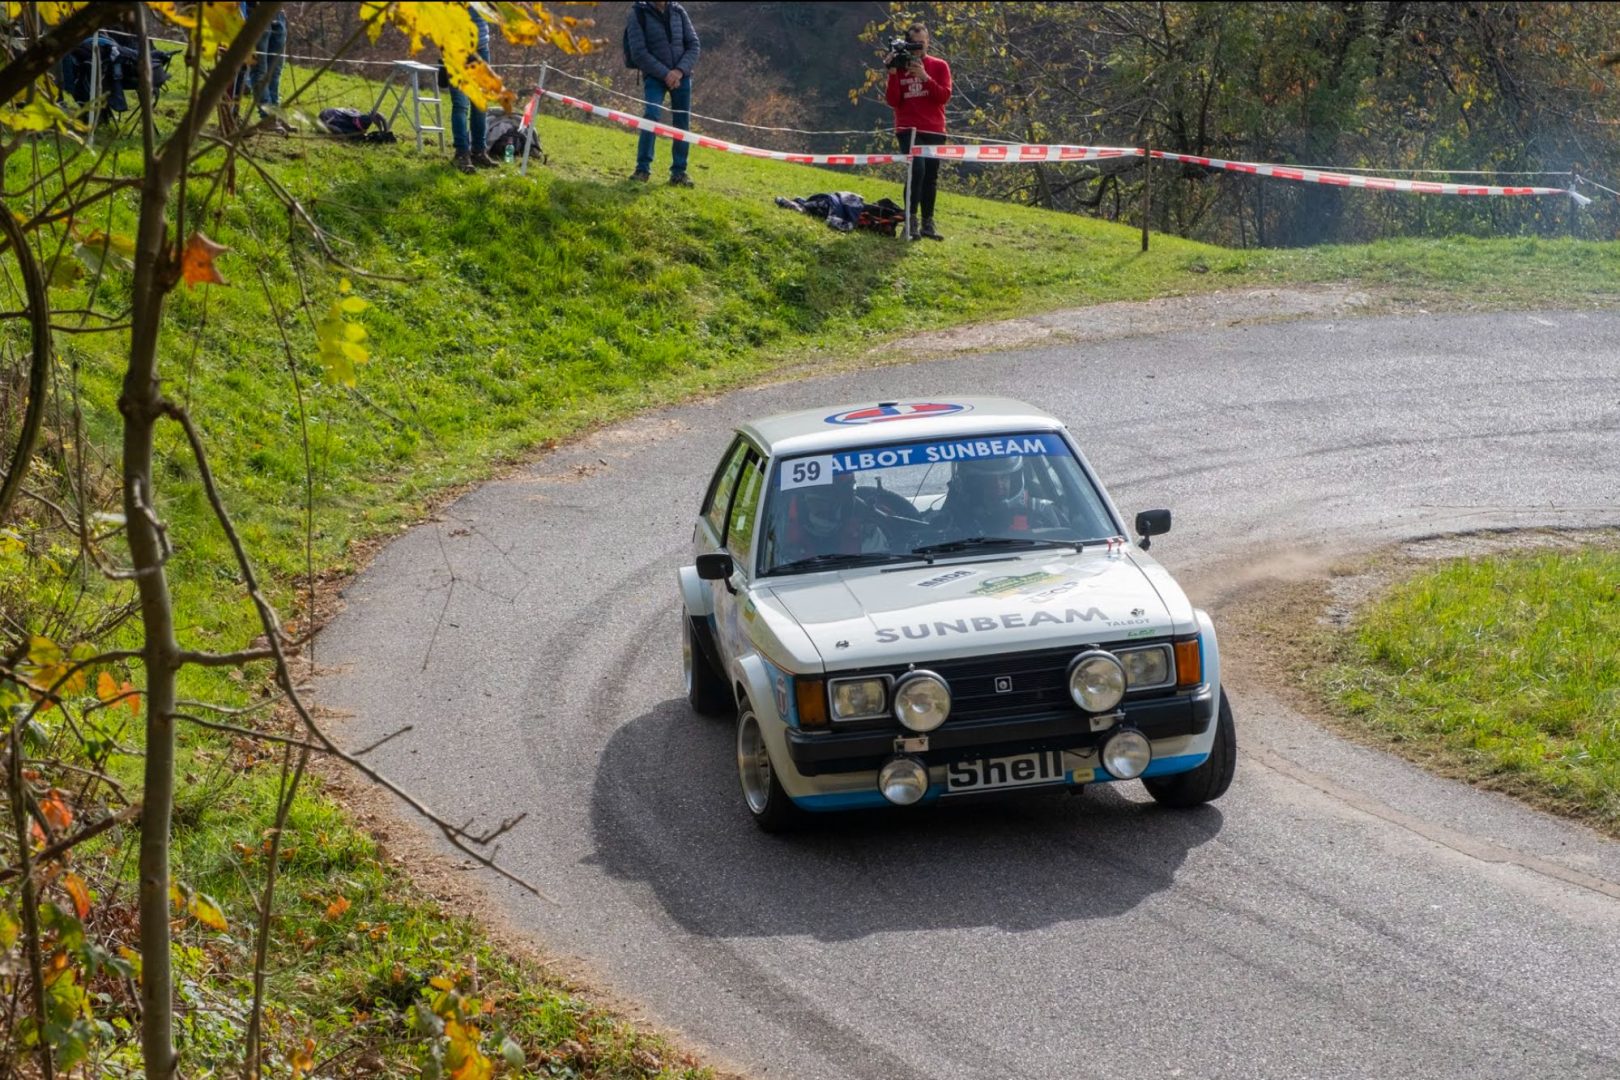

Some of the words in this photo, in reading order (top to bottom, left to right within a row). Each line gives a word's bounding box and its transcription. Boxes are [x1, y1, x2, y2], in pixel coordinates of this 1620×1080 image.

[791, 461, 821, 483] 59
[832, 449, 913, 472] ALBOT
[926, 438, 1047, 461] SUNBEAM
[874, 606, 1110, 643] SUNBEAM
[1105, 618, 1149, 627] TALBOT
[950, 750, 1063, 788] Shell
